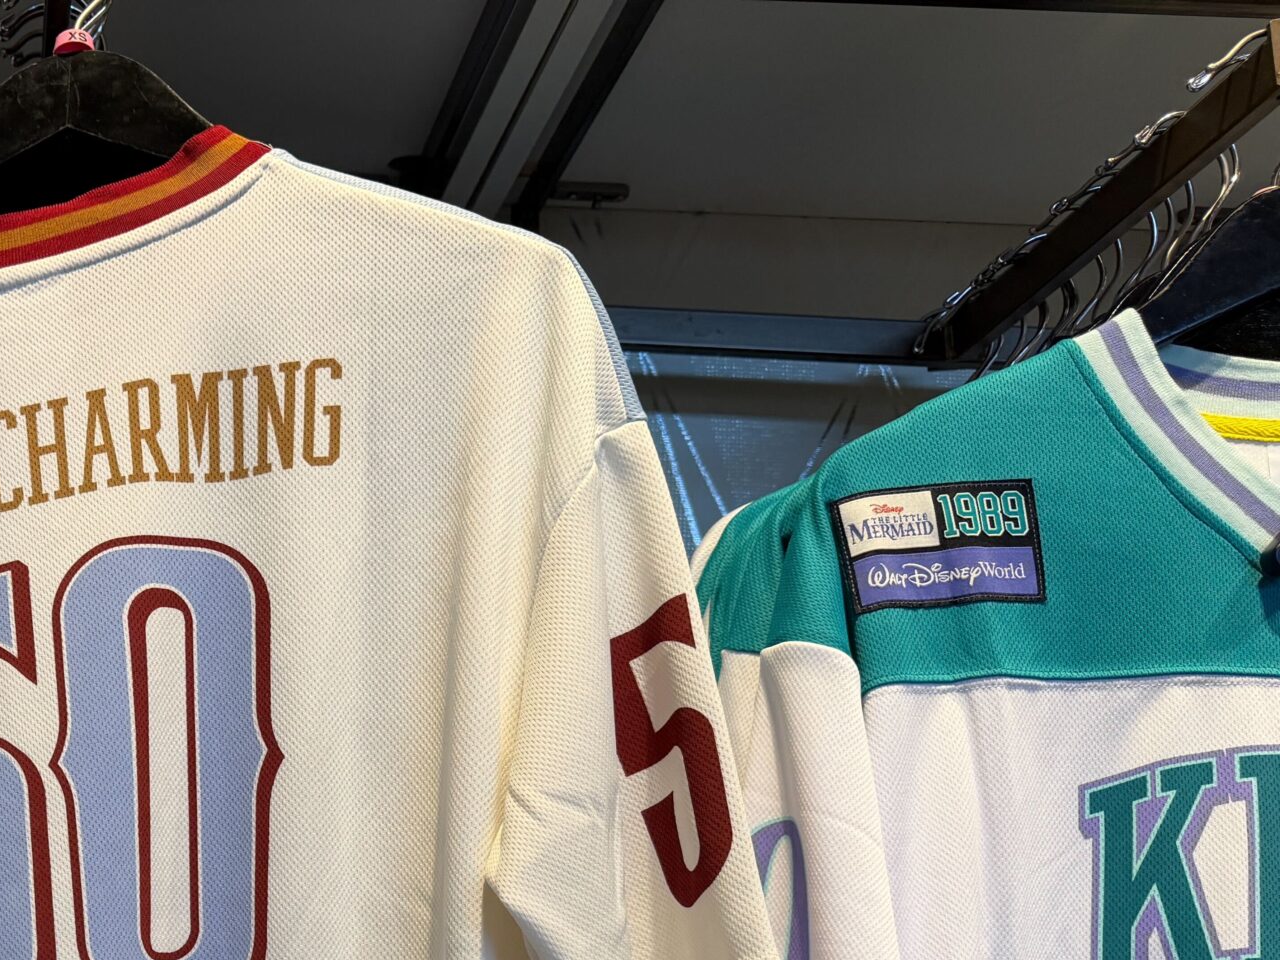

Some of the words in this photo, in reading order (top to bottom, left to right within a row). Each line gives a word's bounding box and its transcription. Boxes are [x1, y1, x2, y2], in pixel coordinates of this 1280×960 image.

[68, 31, 88, 42] XS
[870, 503, 904, 515] Disney
[871, 516, 891, 524] THE
[893, 512, 928, 523] LITTLE
[937, 490, 1030, 539] 1989
[848, 518, 934, 545] MERMAID
[978, 561, 1027, 579] World
[609, 593, 733, 908] 5
